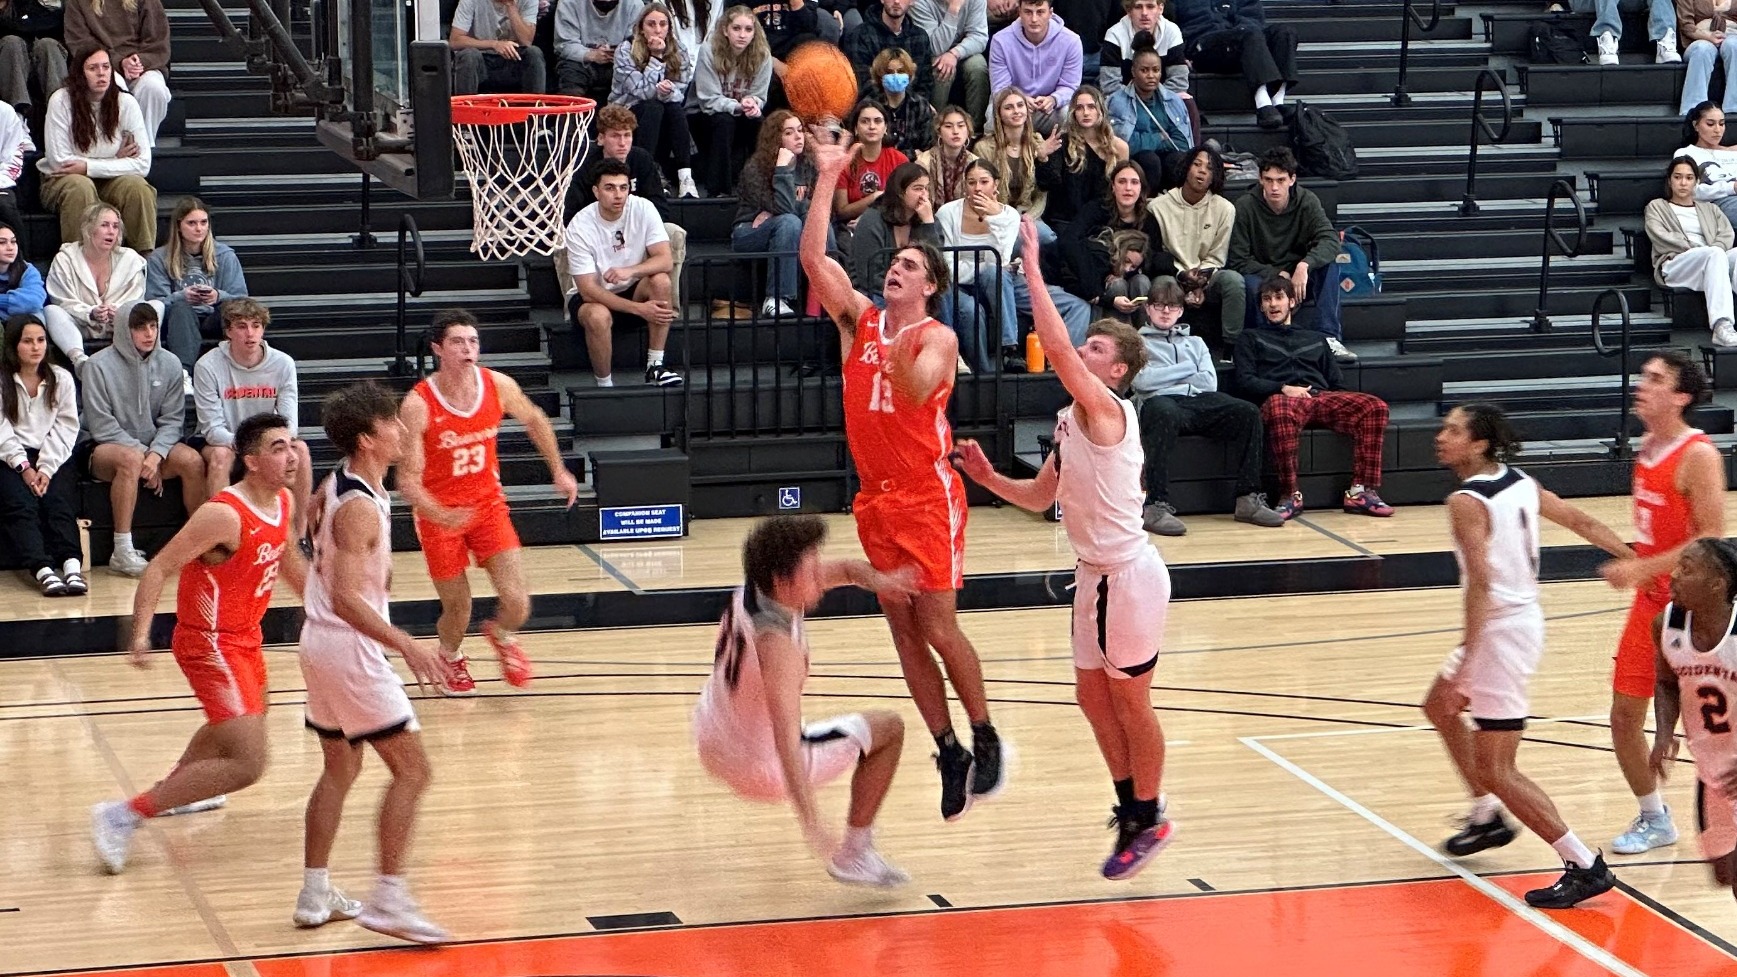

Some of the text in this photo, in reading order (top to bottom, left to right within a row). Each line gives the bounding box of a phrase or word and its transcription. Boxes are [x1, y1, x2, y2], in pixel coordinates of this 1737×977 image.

[452, 443, 486, 477] 23
[602, 528, 634, 536] AVAILABLE
[1696, 685, 1731, 733] 2
